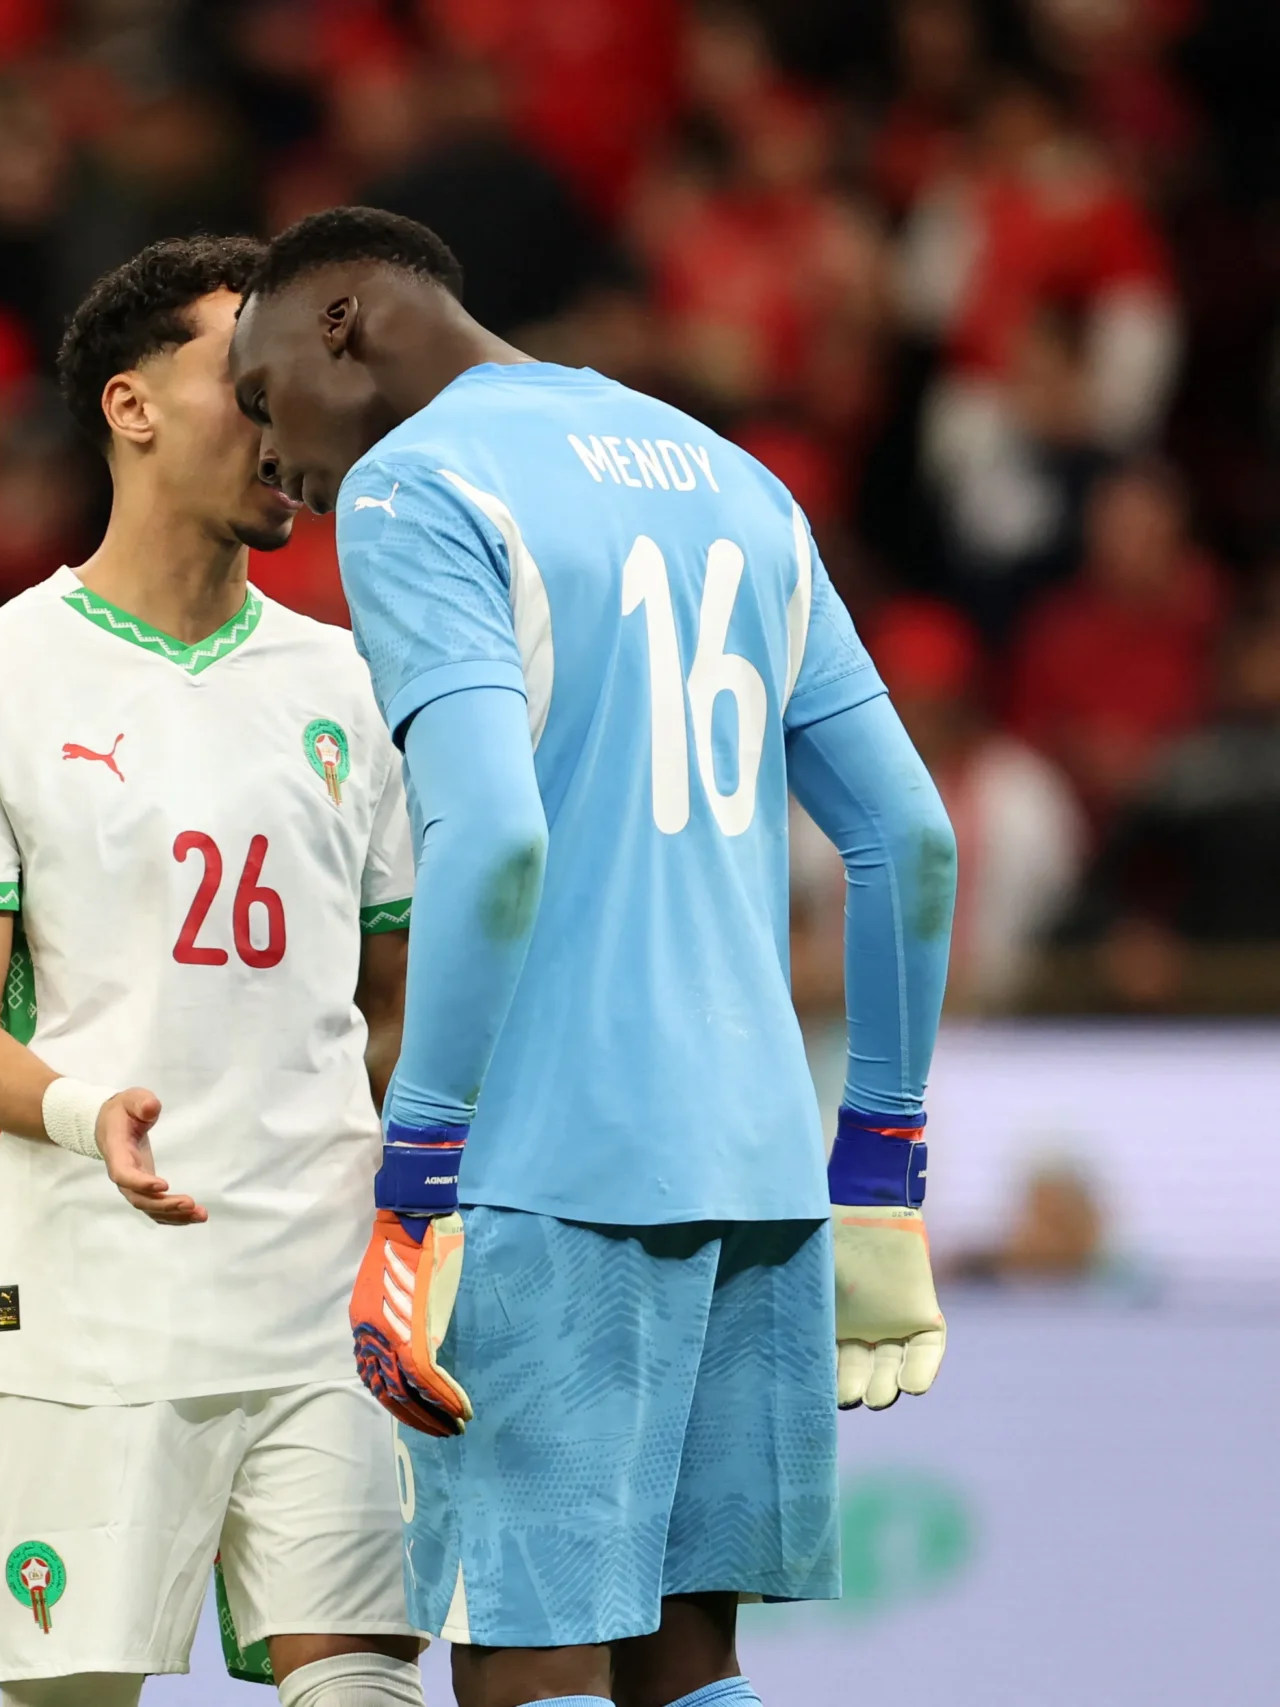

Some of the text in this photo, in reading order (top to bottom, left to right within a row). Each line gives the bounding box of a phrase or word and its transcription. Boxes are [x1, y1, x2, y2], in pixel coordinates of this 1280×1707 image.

[567, 434, 720, 493] MENDY
[621, 534, 767, 837] 16
[172, 830, 287, 969] 26
[424, 1176, 453, 1184] MENDY
